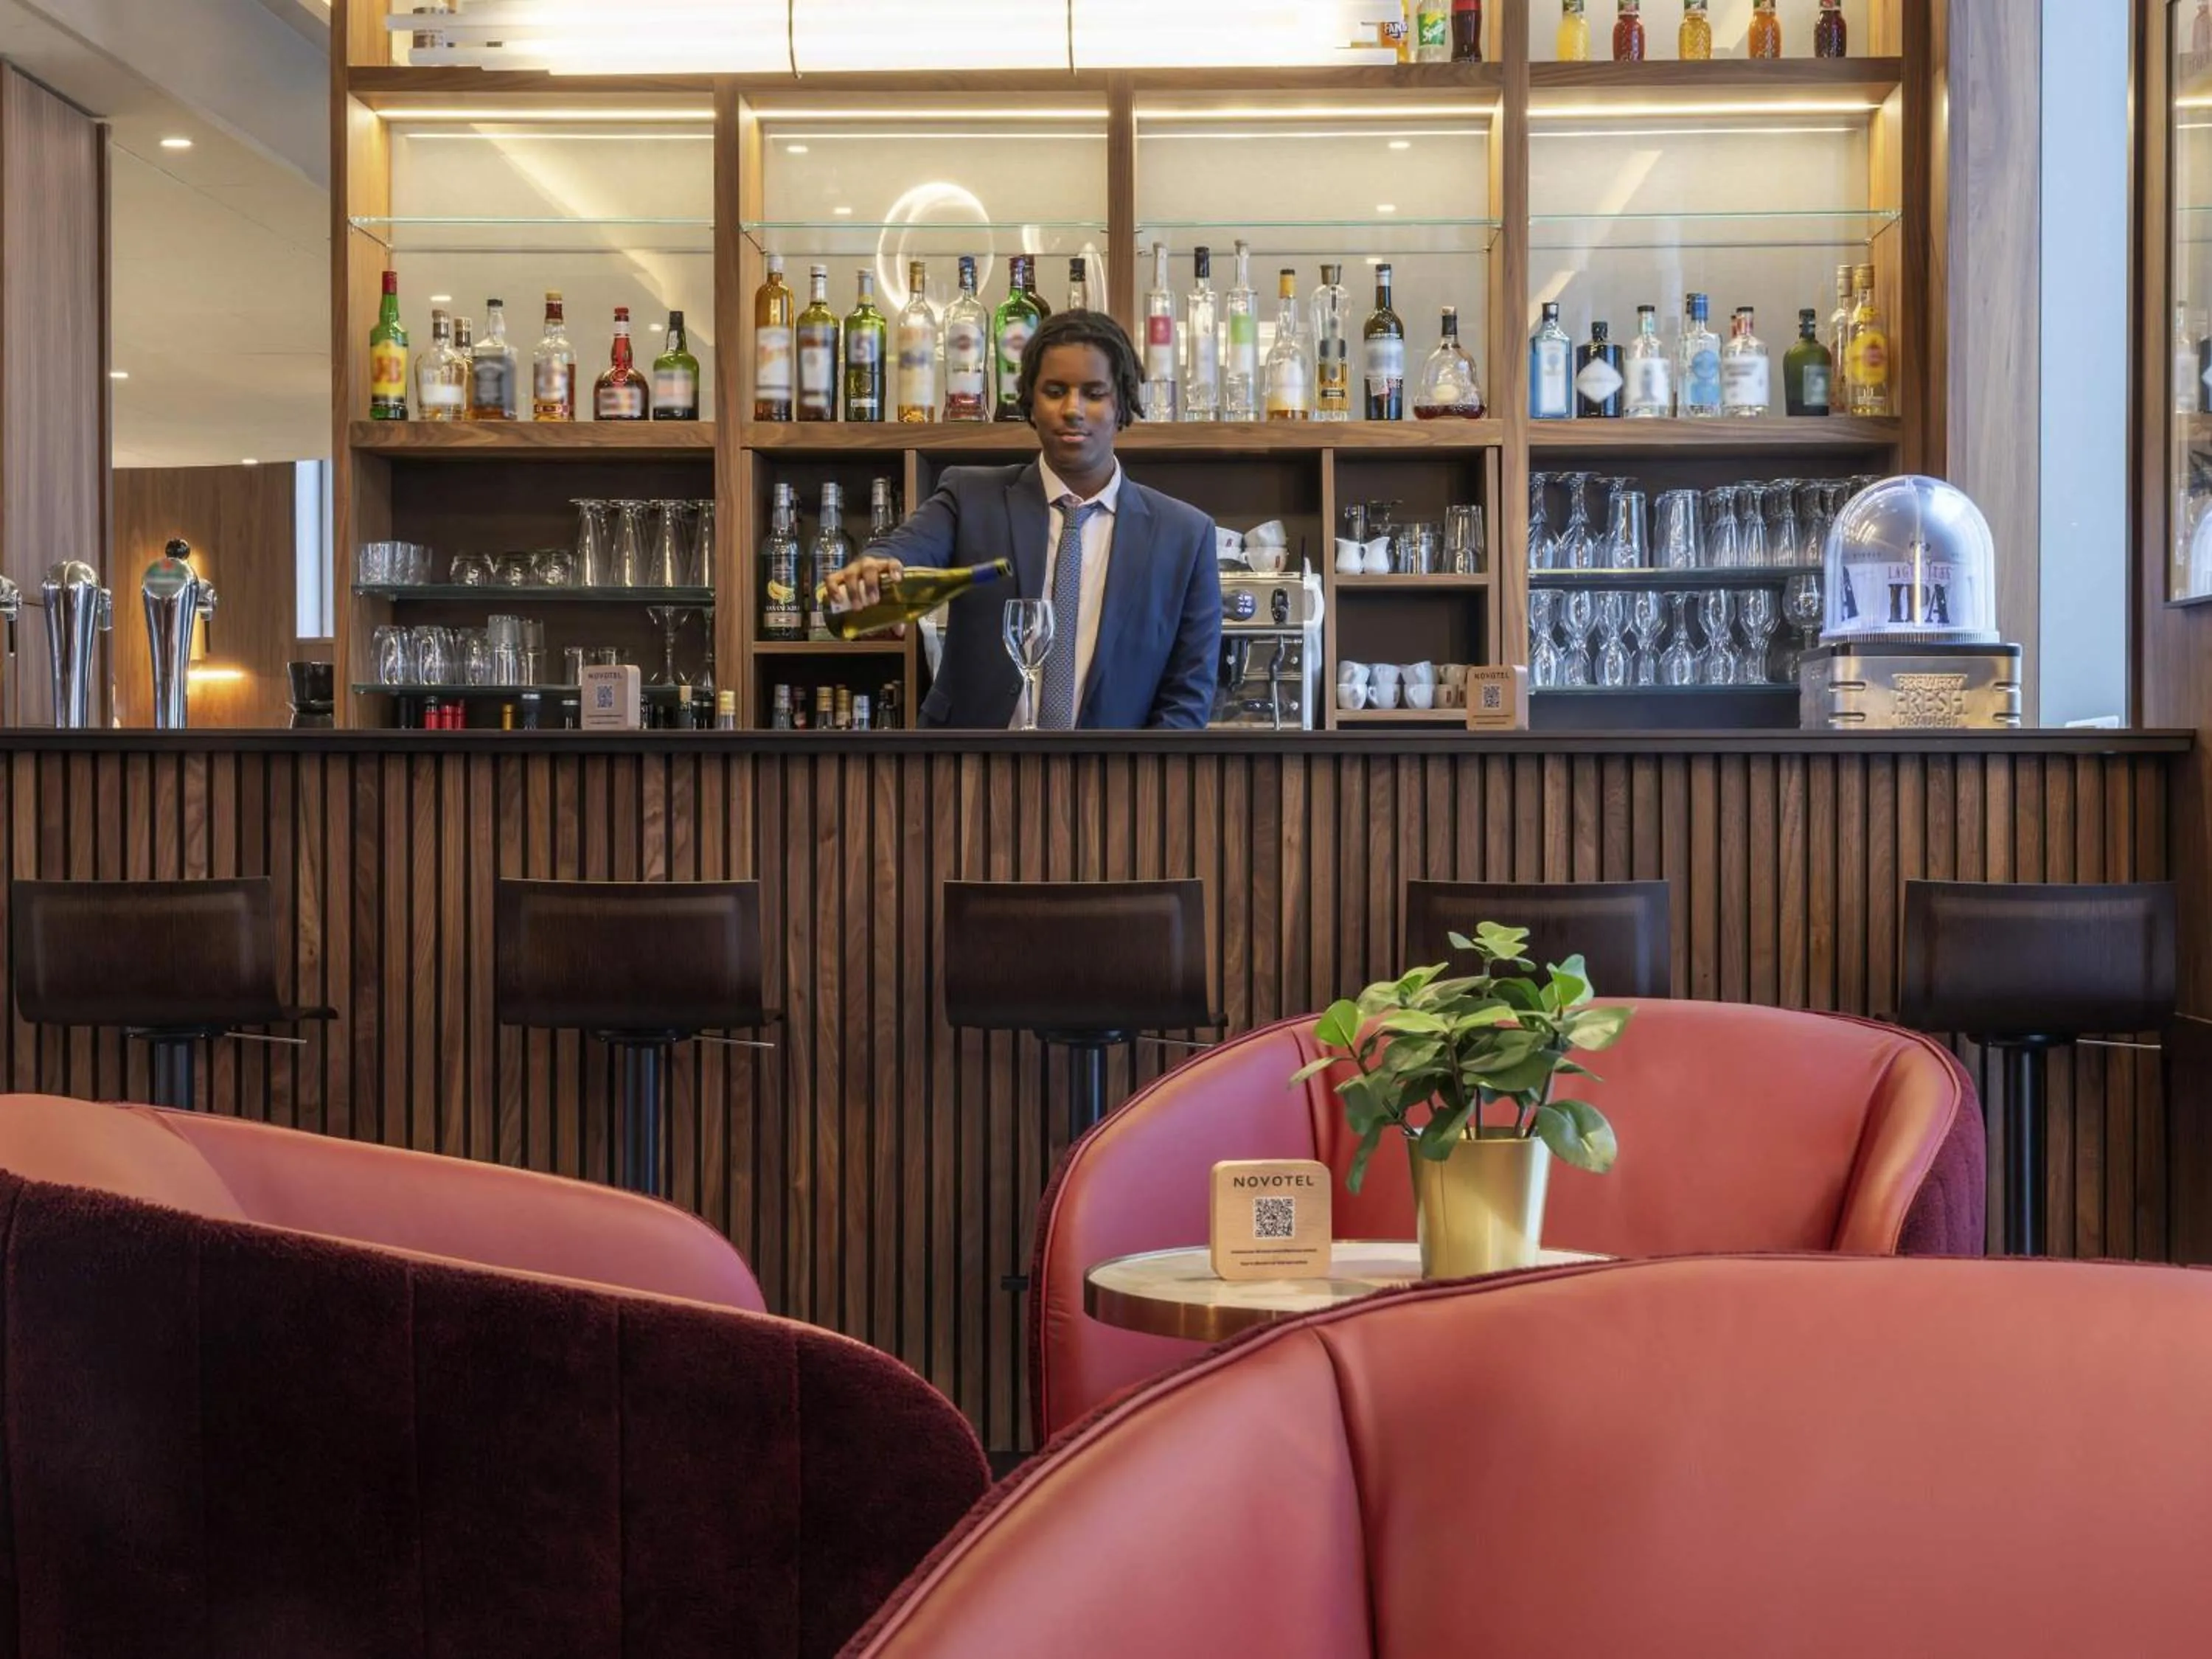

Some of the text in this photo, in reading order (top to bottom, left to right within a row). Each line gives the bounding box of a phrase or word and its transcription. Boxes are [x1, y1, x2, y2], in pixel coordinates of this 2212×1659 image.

[1888, 583, 1950, 624] IPA
[1892, 689, 1967, 714] FRESH
[1234, 1175, 1315, 1188] NOVOTEL
